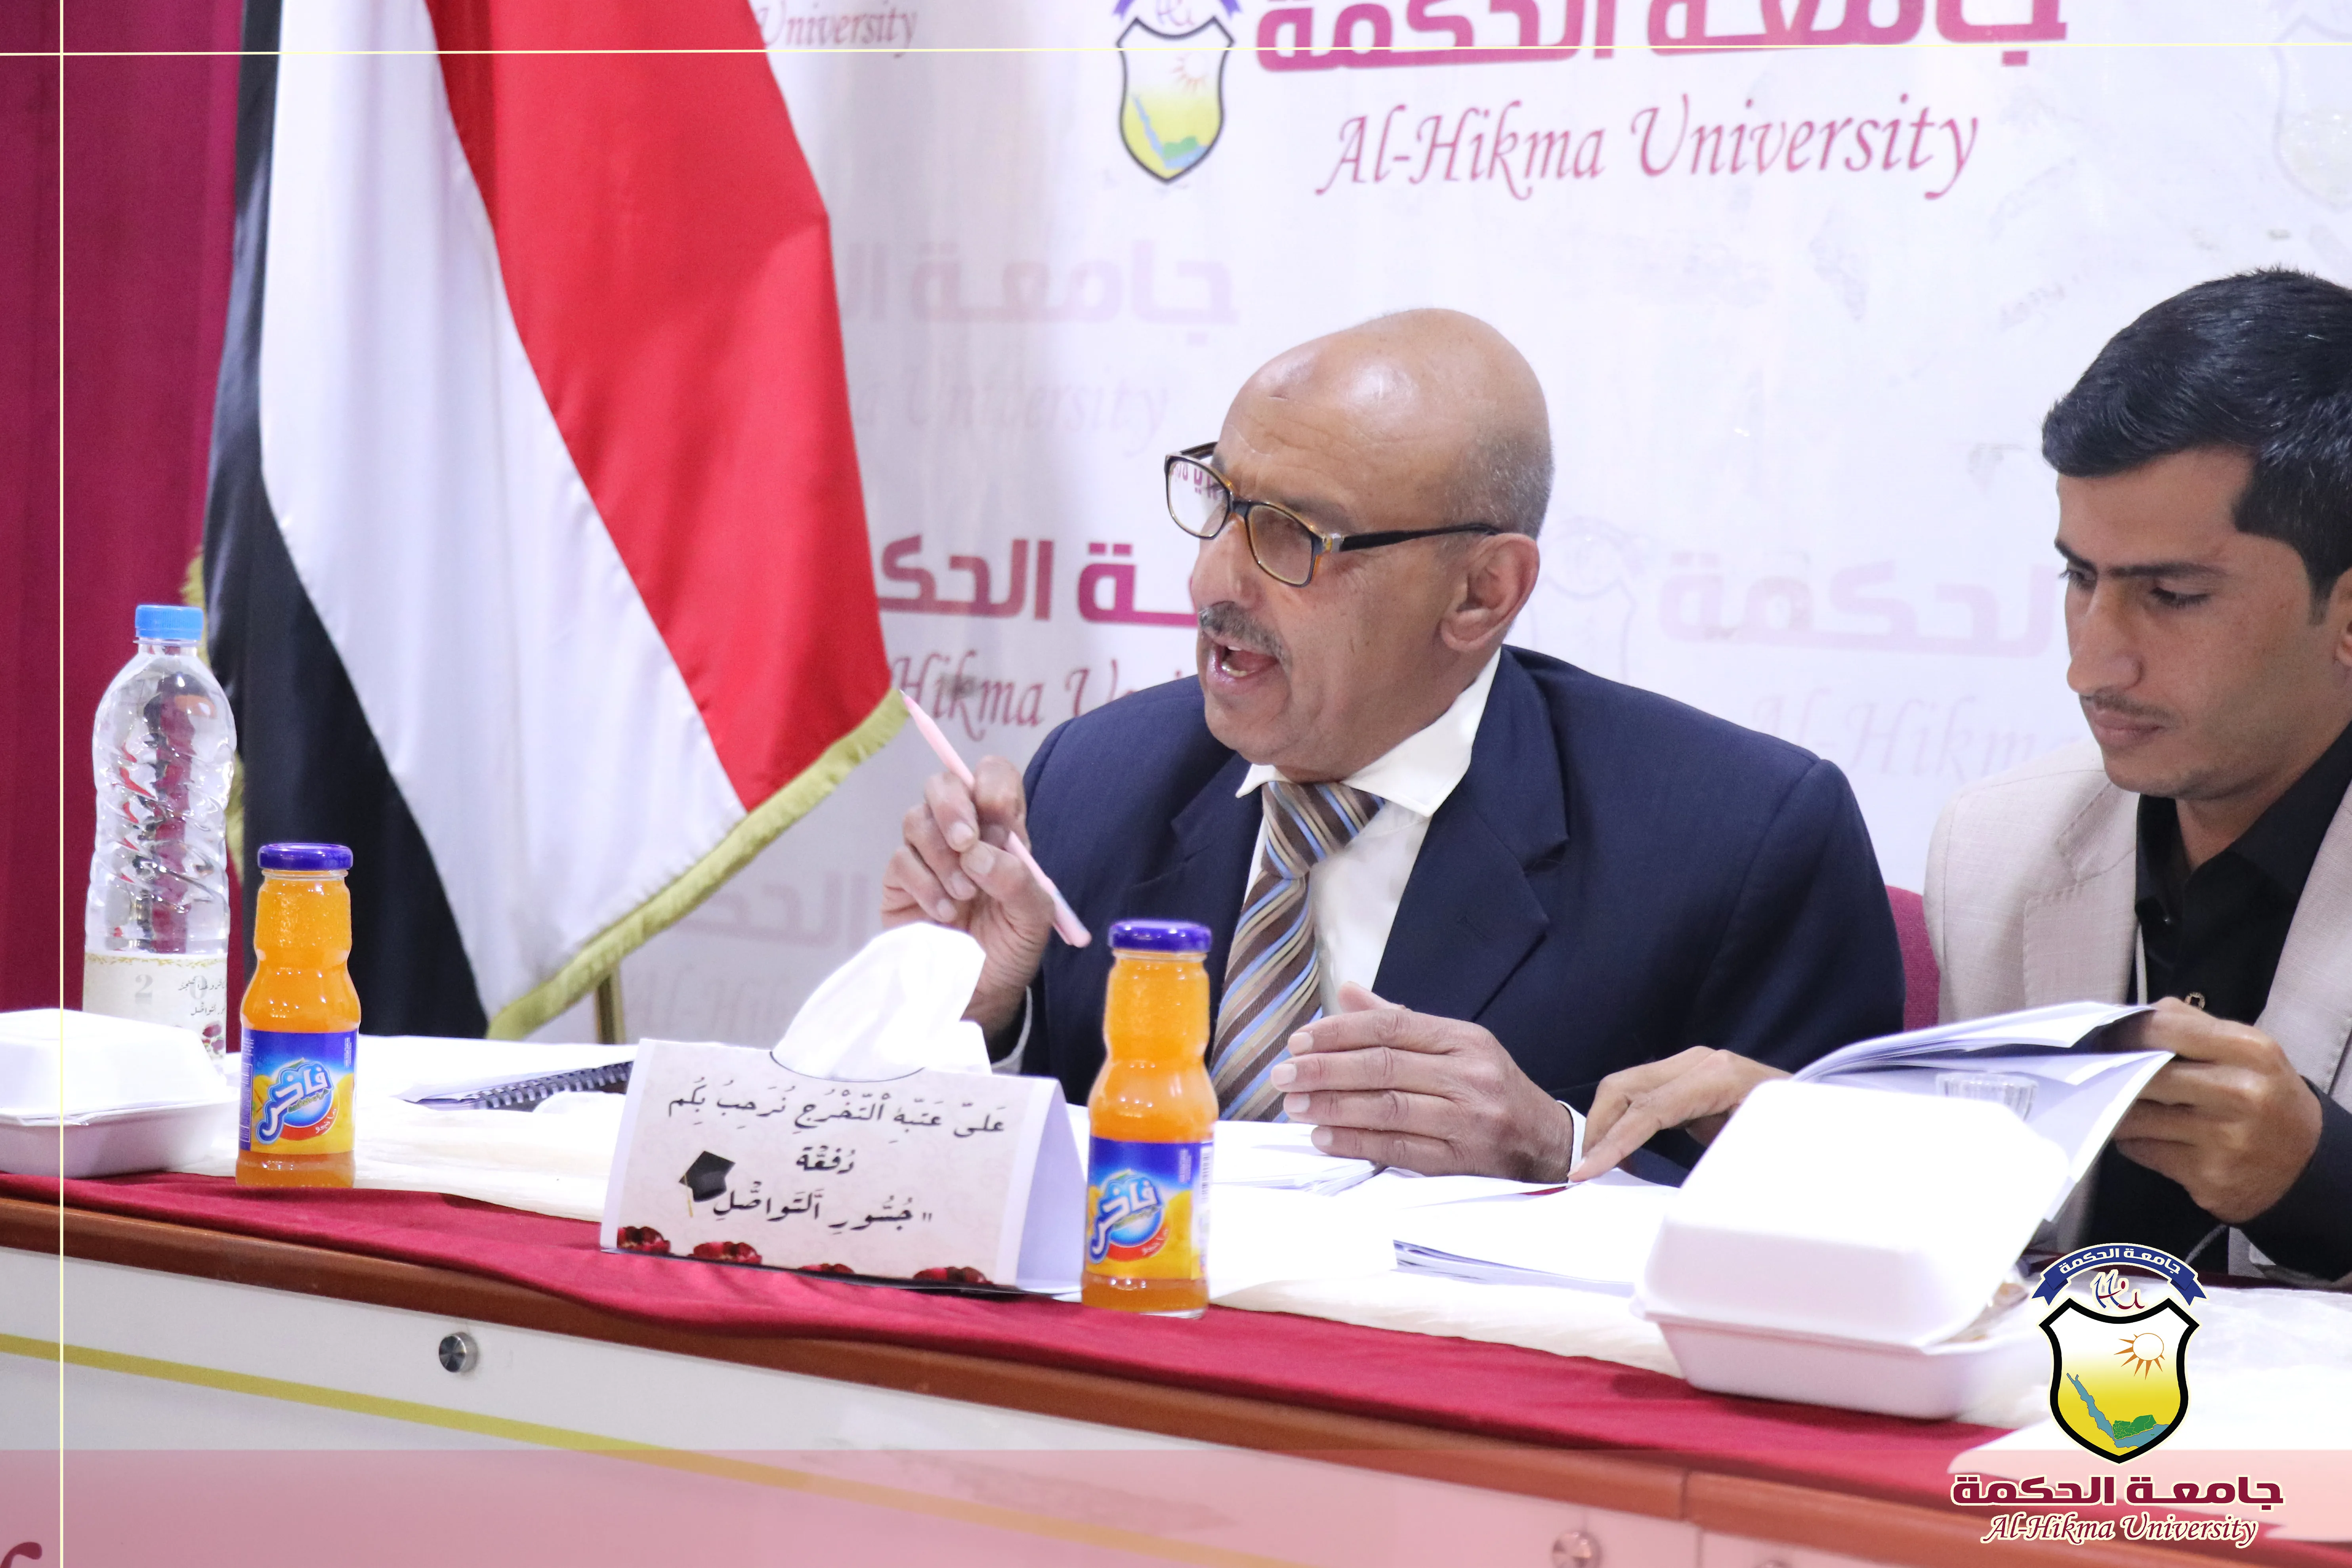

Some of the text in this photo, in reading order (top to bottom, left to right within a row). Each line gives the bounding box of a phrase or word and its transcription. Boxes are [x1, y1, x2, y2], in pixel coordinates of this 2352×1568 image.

[1315, 93, 1978, 200] Al-Hikma University
[910, 238, 1239, 346] جامعة
[878, 535, 1054, 621] الحك
[1659, 551, 2053, 658] لحكمة
[892, 649, 1046, 742] Hikma
[260, 1065, 330, 1138] فاخر
[1090, 1178, 1159, 1257] فاخر
